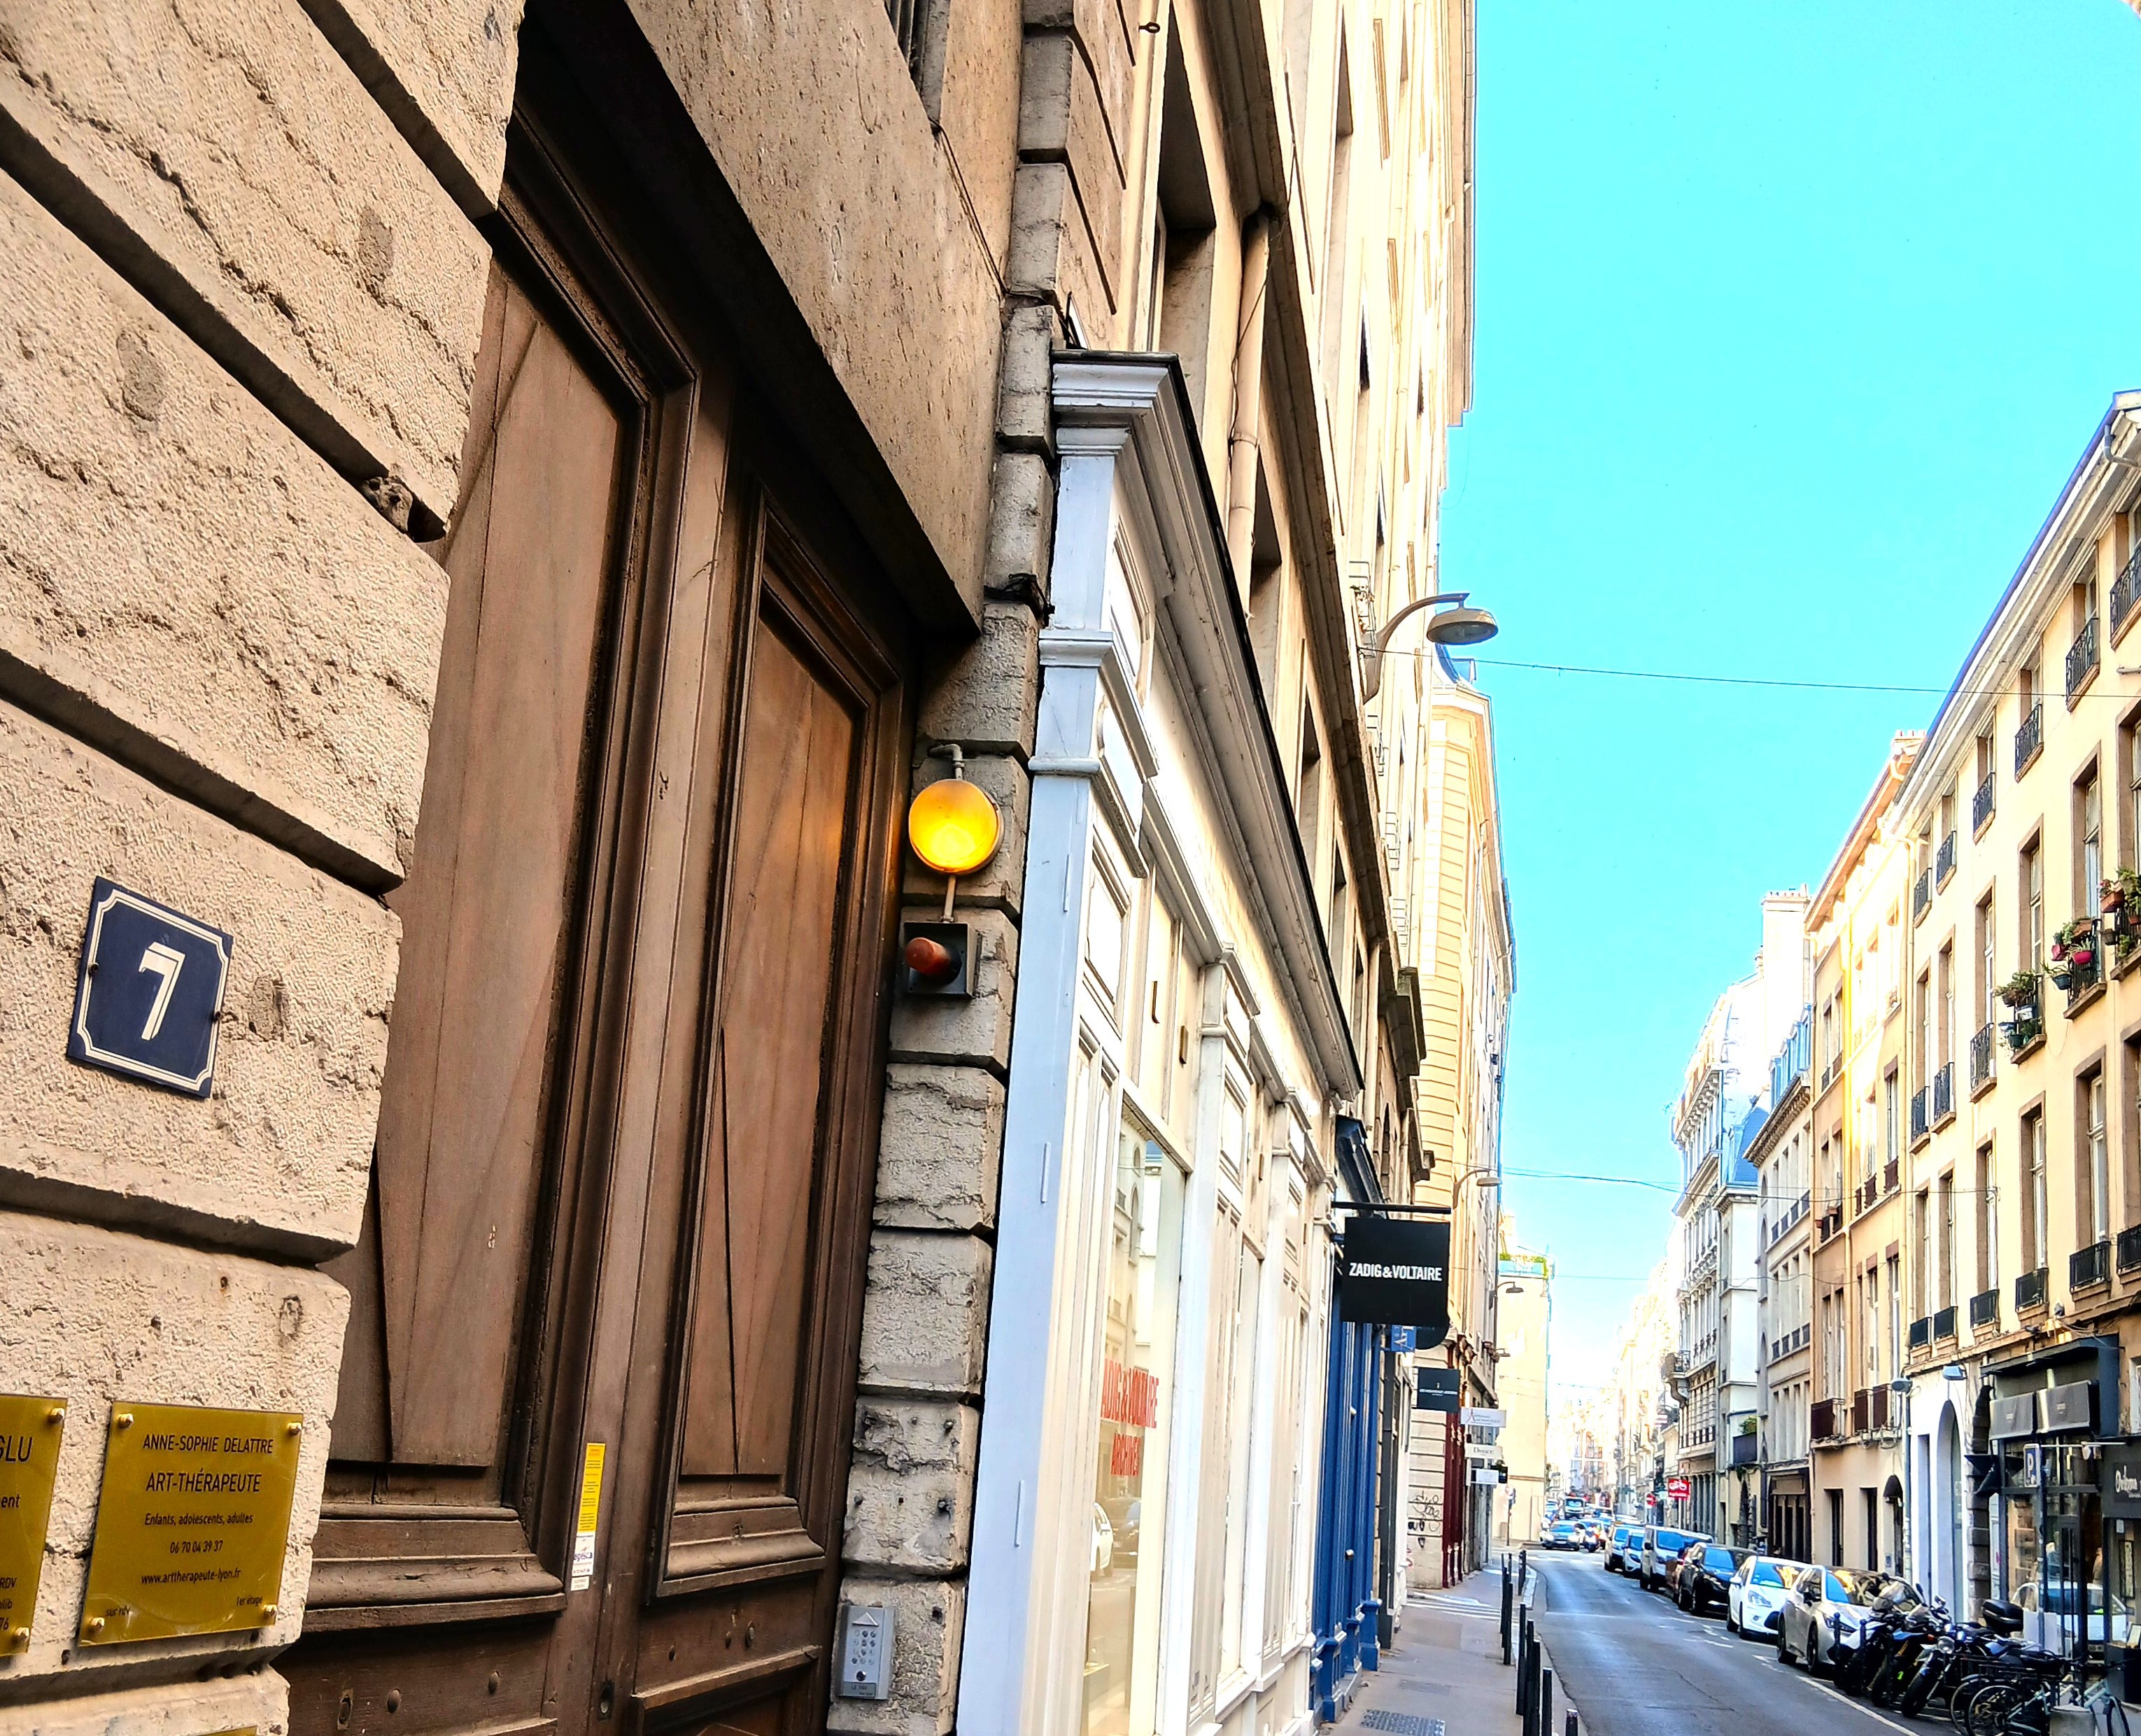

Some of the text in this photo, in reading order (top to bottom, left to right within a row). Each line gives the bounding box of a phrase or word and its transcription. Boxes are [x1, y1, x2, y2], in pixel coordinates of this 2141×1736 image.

[139, 941, 186, 1041] 7
[1349, 1262, 1443, 1281] ZADIG&VOLTAIRE
[143, 1434, 274, 1454] ANNE-SOPHIE DELATTRE
[146, 1468, 262, 1492] ART-THÉRAPEUTE
[145, 1511, 254, 1526] Enfants, adolescents, adultes
[170, 1541, 179, 1554] 06
[182, 1541, 191, 1553] 70
[214, 1539, 224, 1552] 37
